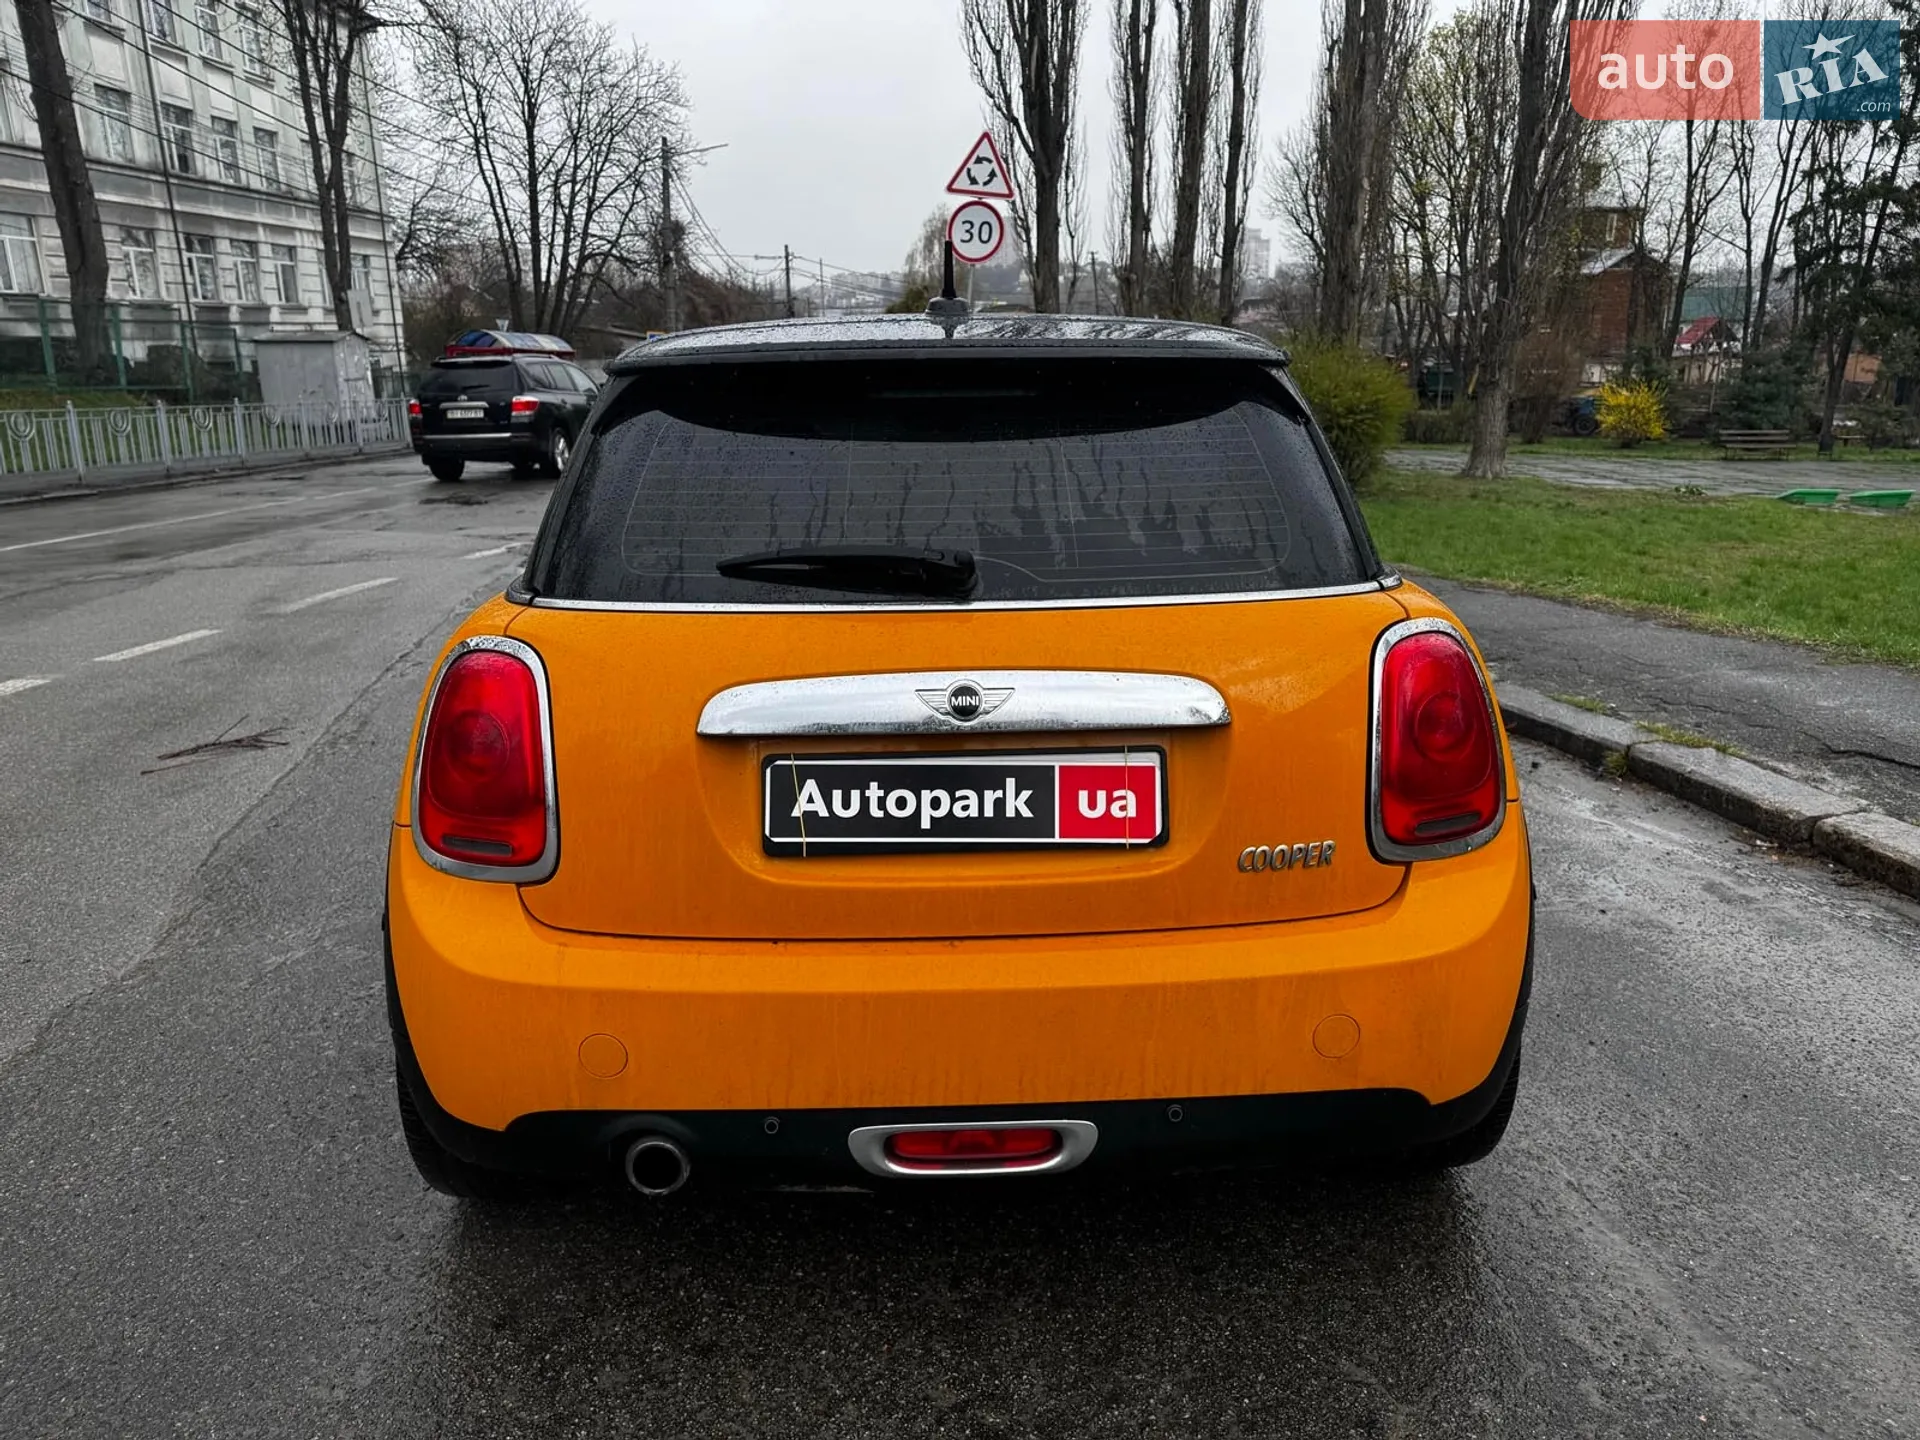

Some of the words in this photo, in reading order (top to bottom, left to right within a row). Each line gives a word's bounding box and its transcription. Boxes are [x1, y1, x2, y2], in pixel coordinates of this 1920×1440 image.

[960, 220, 993, 244] 30
[951, 695, 980, 707] MINI
[791, 778, 1034, 829] Autopark
[1078, 788, 1137, 818] ua
[1238, 840, 1335, 872] COOPER
